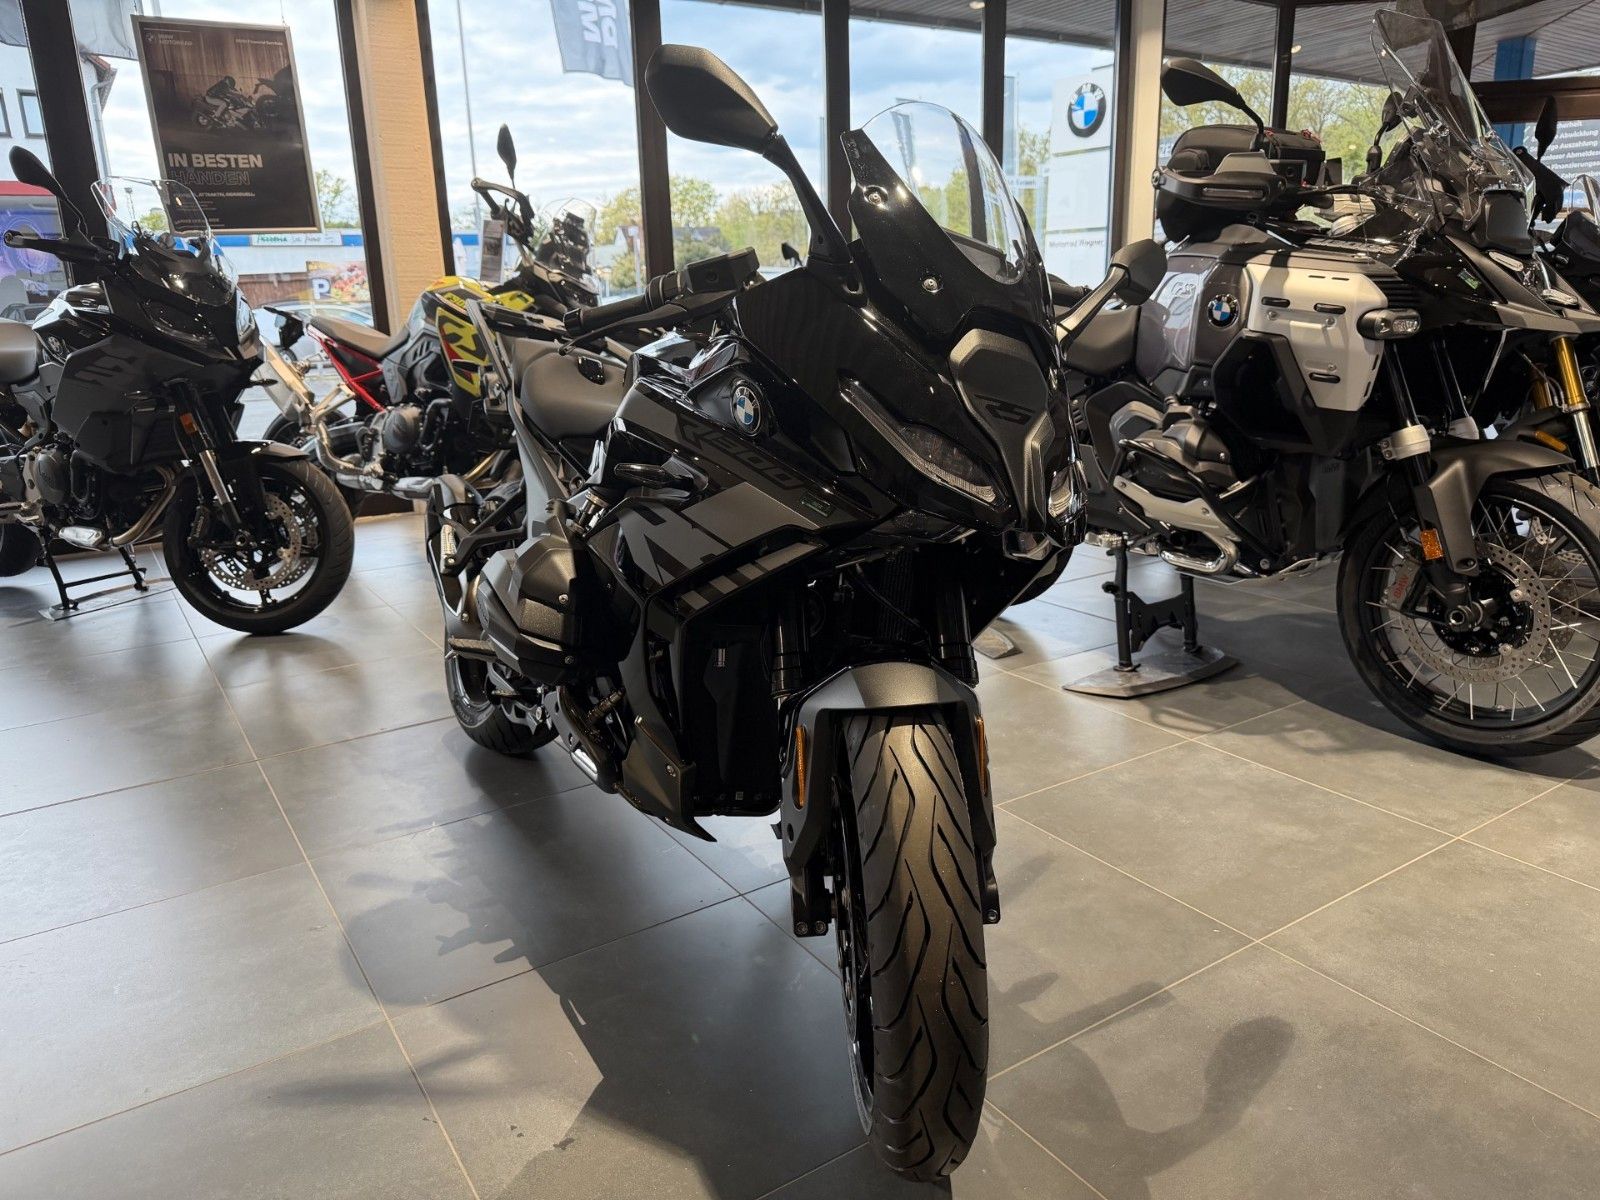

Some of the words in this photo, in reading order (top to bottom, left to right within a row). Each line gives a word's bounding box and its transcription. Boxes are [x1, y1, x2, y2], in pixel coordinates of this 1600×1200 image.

[168, 153, 187, 168] IN
[191, 153, 263, 168] BESTEN
[171, 167, 251, 186] HÄNDEN
